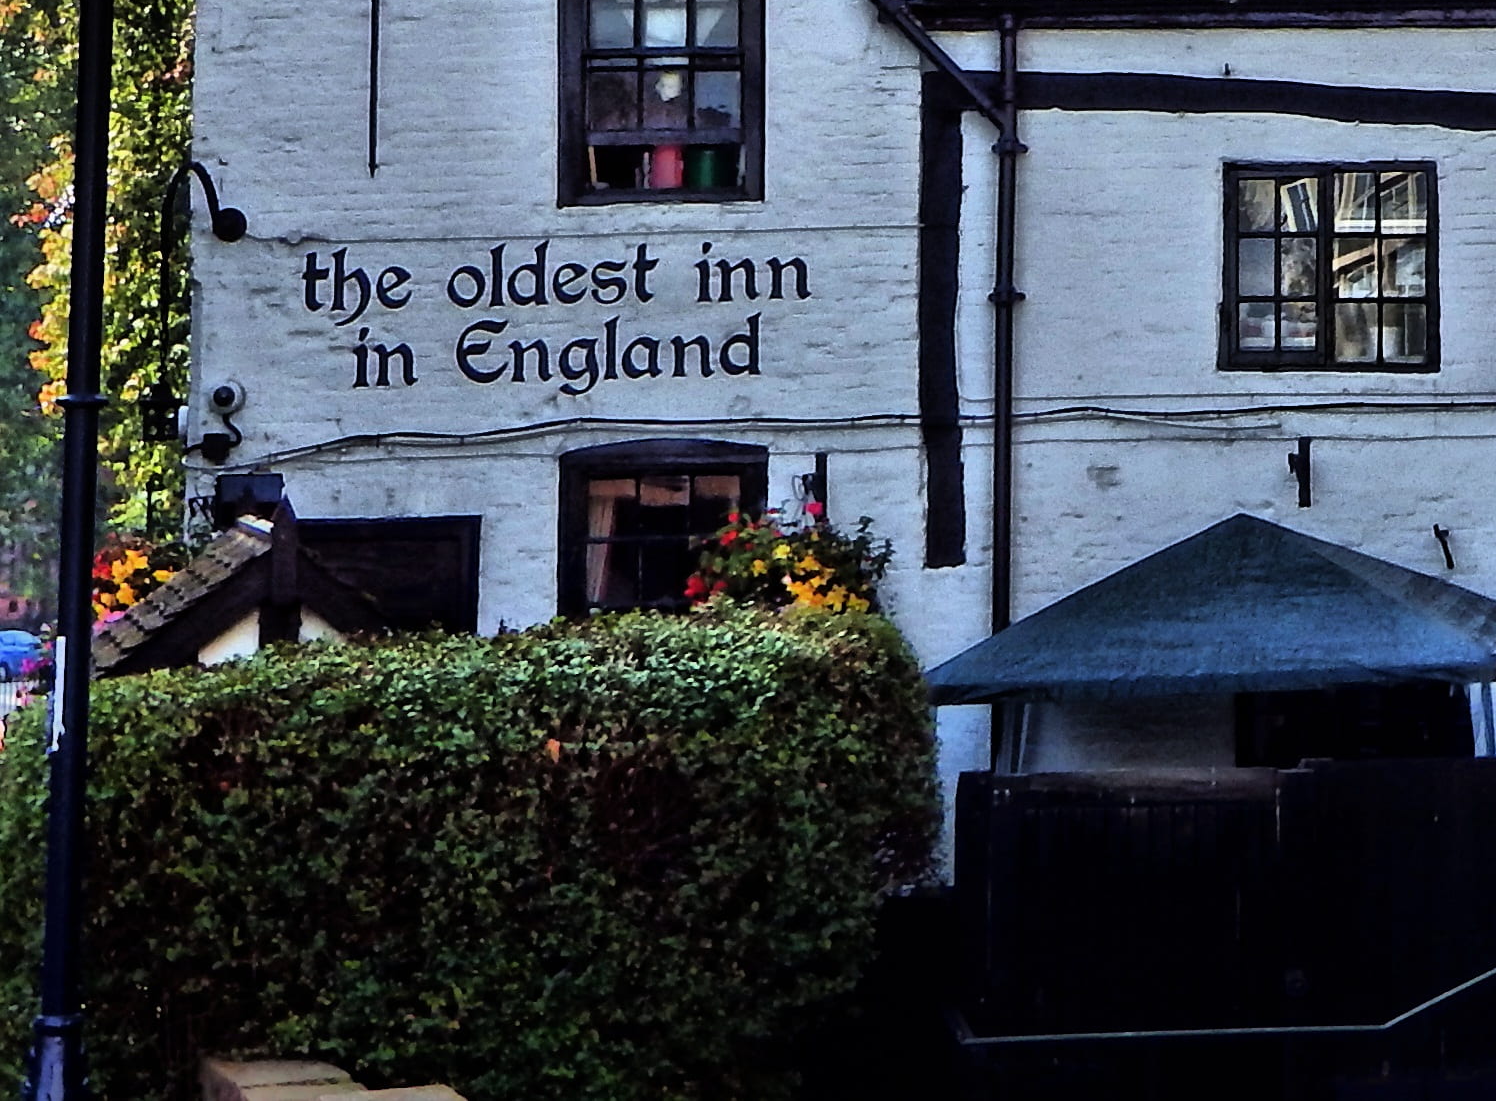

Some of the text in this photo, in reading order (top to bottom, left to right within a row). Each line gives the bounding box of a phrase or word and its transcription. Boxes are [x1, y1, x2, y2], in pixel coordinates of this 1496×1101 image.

[301, 240, 813, 327] the oldest inn
[351, 311, 762, 396] in England
